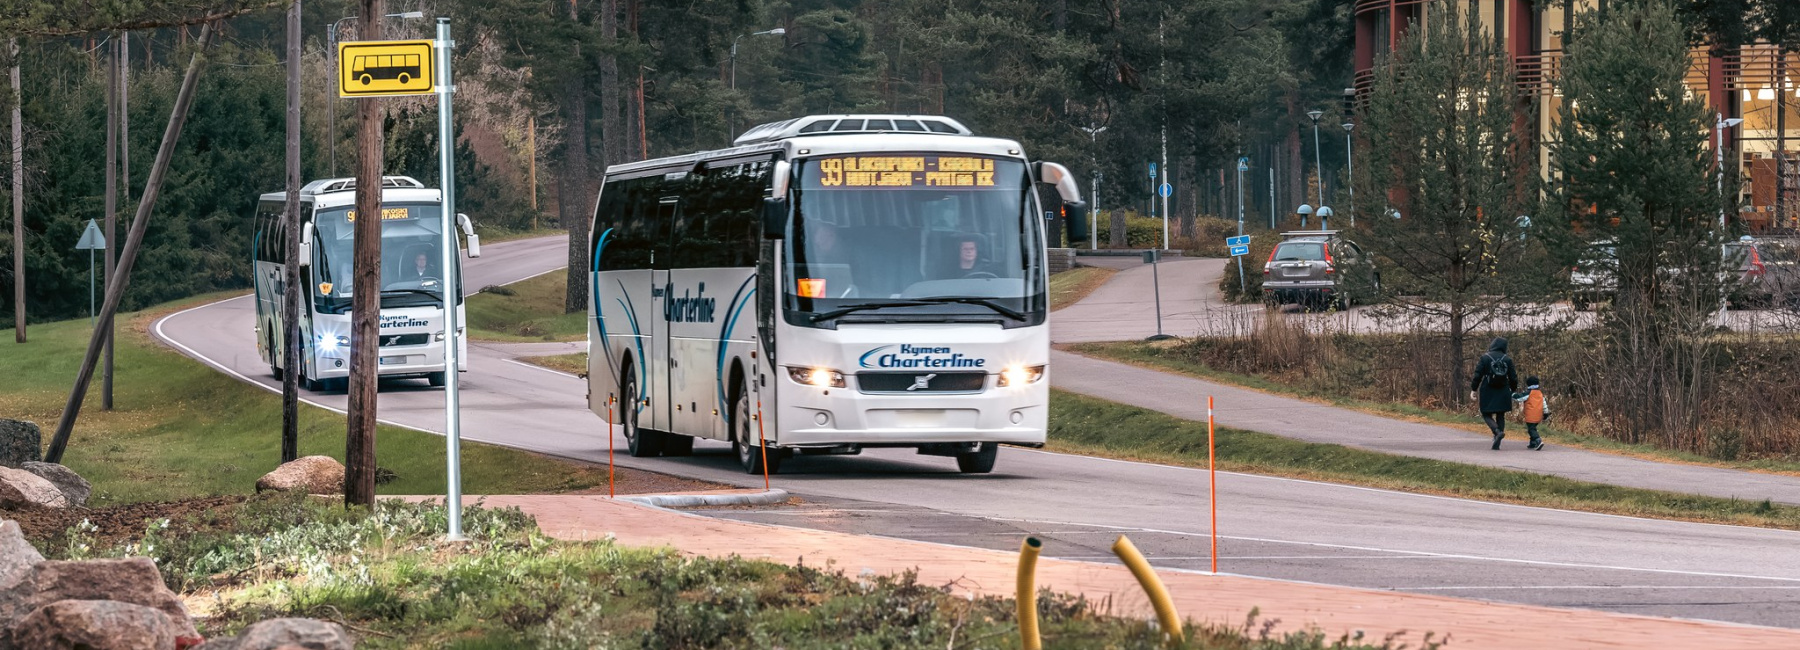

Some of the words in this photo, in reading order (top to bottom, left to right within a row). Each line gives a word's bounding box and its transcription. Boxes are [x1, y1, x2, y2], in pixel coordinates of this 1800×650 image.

[821, 158, 842, 186] 99
[663, 281, 715, 323] Charterline
[380, 318, 429, 328] arterline
[900, 343, 951, 356] Kymen
[878, 353, 986, 368] Charterline
